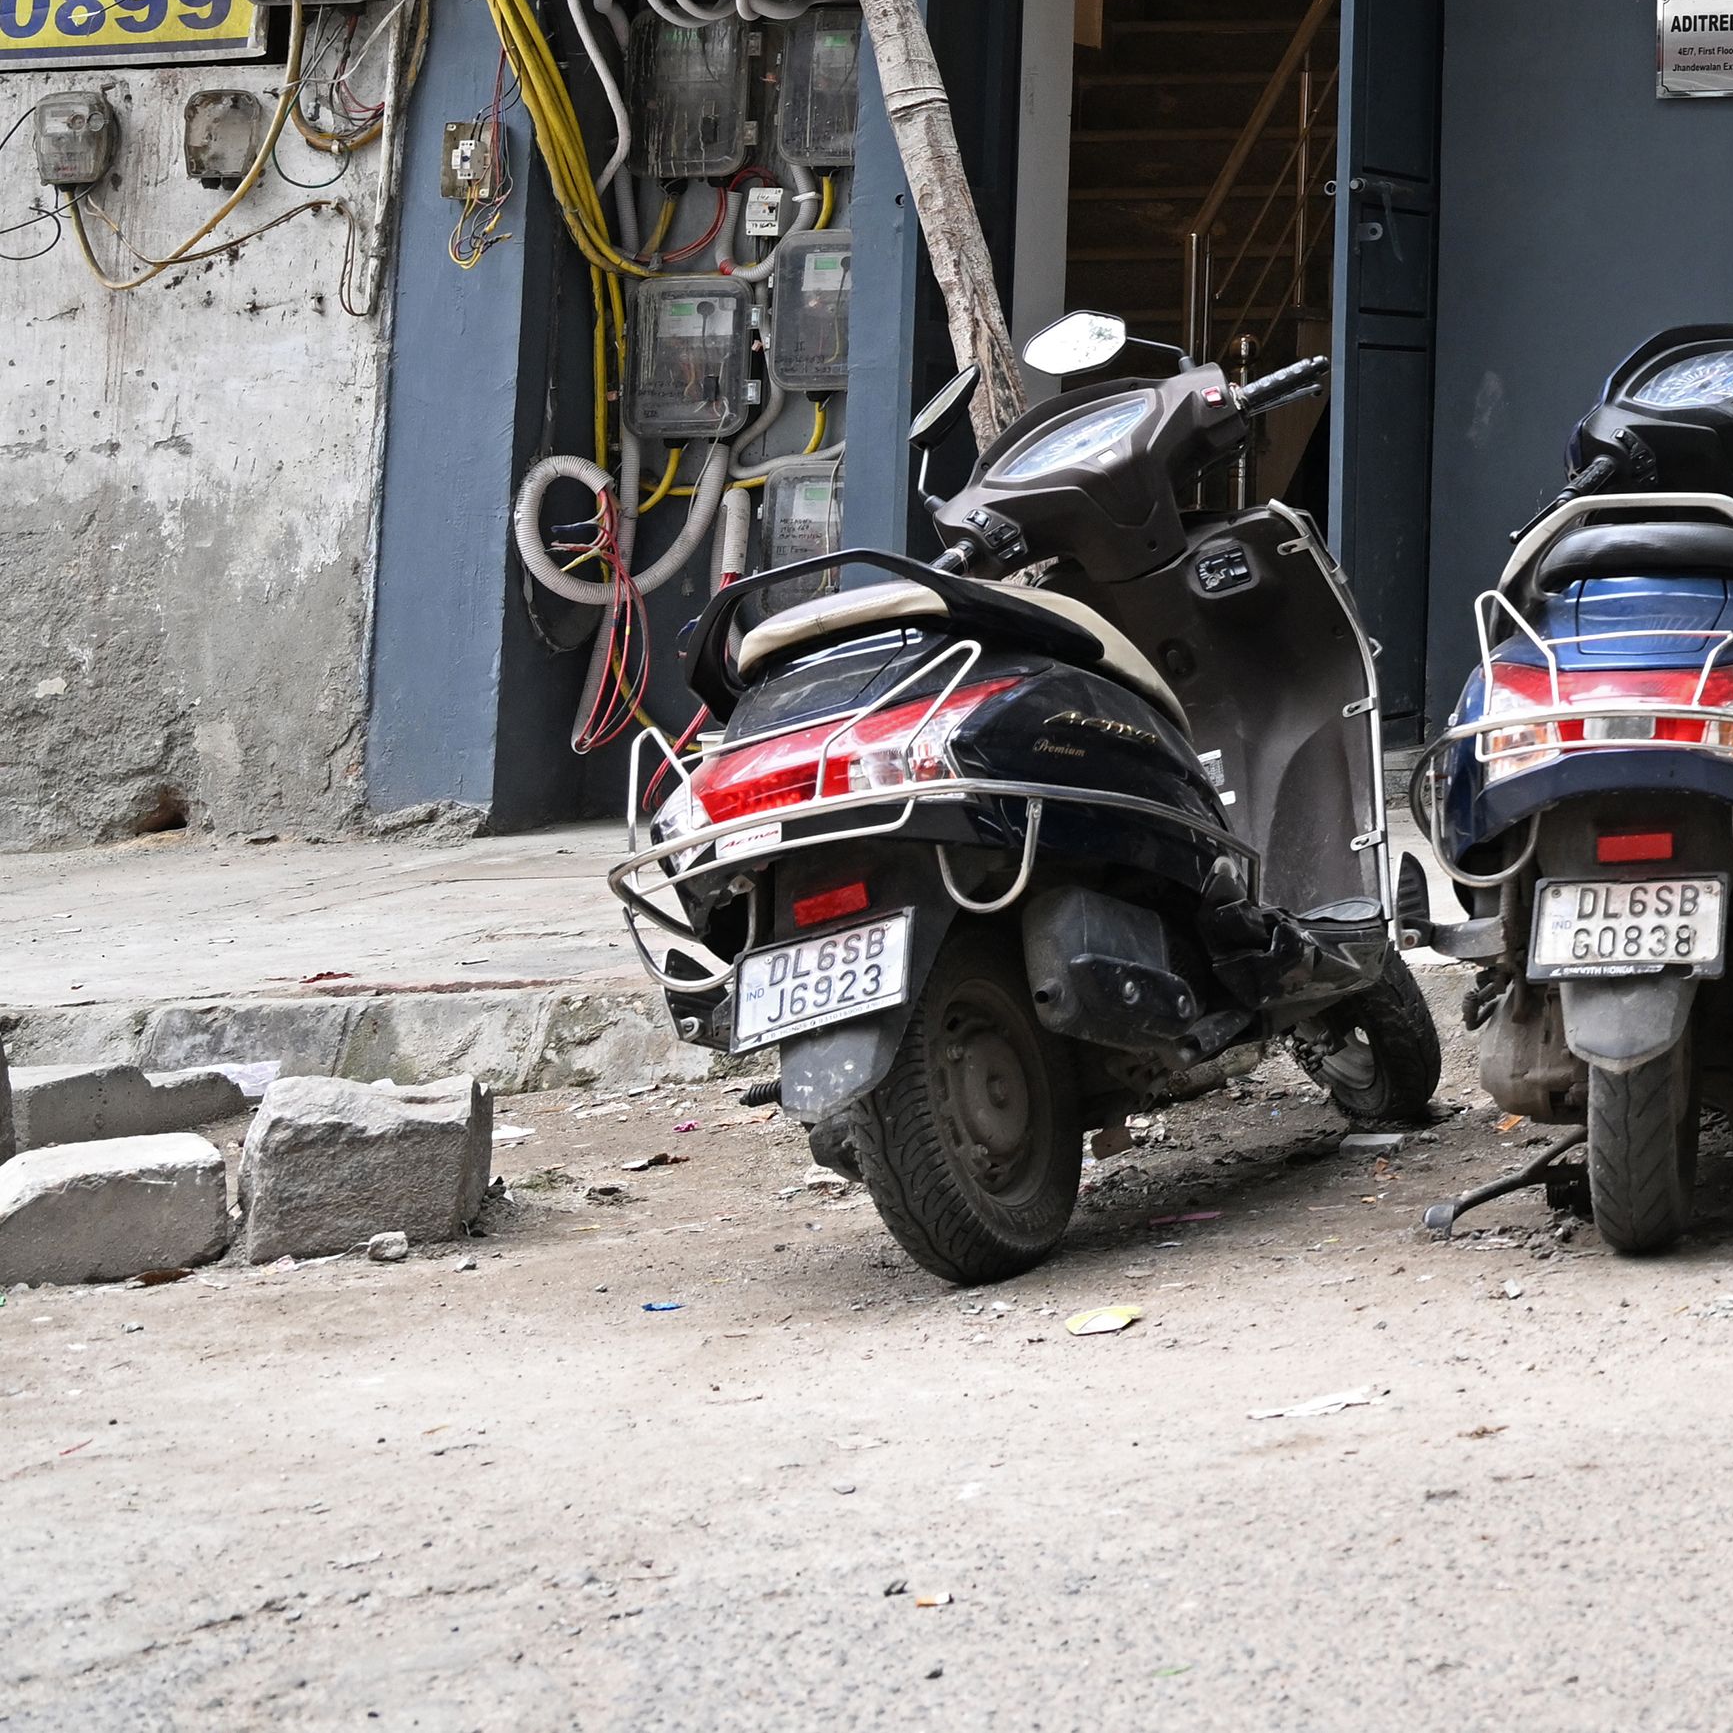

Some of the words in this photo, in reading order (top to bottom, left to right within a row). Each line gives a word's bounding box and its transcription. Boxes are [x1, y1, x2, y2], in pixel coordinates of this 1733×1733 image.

[1672, 63, 1722, 72] Jhandewalan
[1678, 47, 1697, 56] 4E/7,
[1698, 46, 1715, 55] First
[1034, 739, 1087, 757] Premium
[1577, 884, 1700, 920] DL6SB
[769, 927, 886, 987] DL6SB
[1551, 920, 1572, 930] IND
[1572, 924, 1696, 959] G0838
[746, 987, 765, 1003] IND
[768, 964, 882, 1023] J6923
